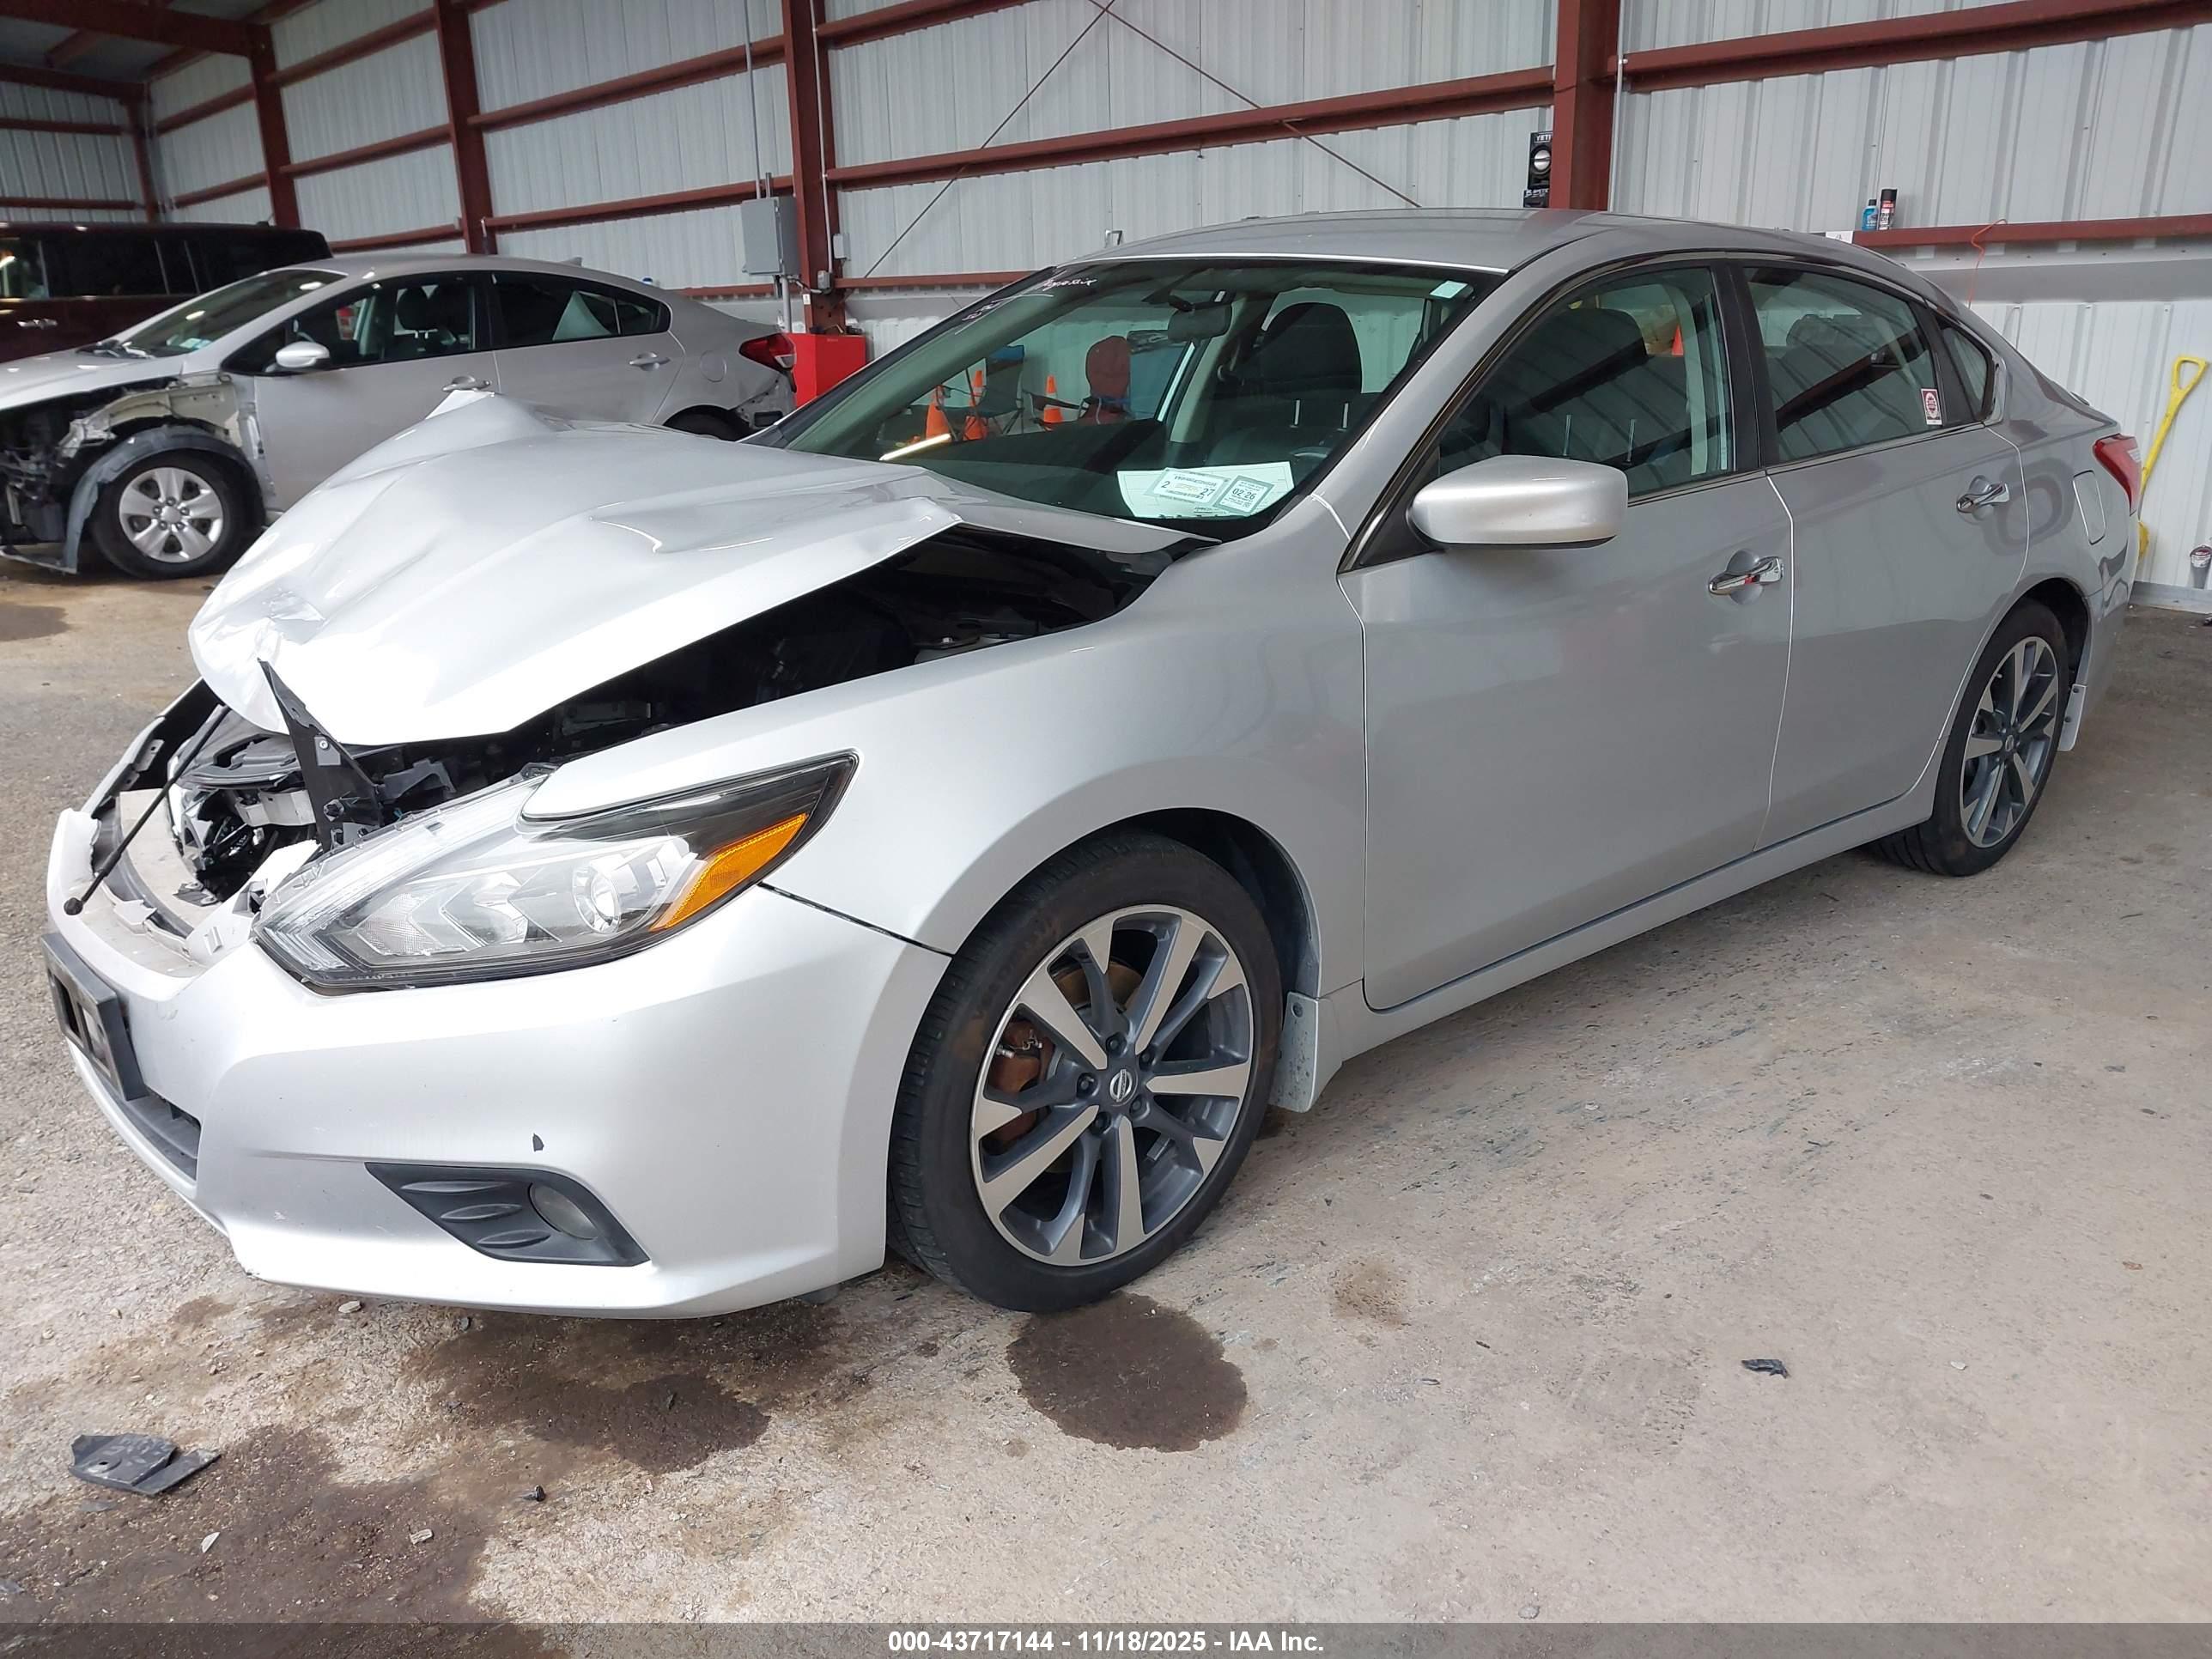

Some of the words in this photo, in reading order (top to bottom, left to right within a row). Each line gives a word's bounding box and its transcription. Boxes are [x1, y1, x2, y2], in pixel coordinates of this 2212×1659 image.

[1200, 488, 1216, 496] 27
[1232, 488, 1245, 496] 02
[1244, 491, 1257, 500] 26
